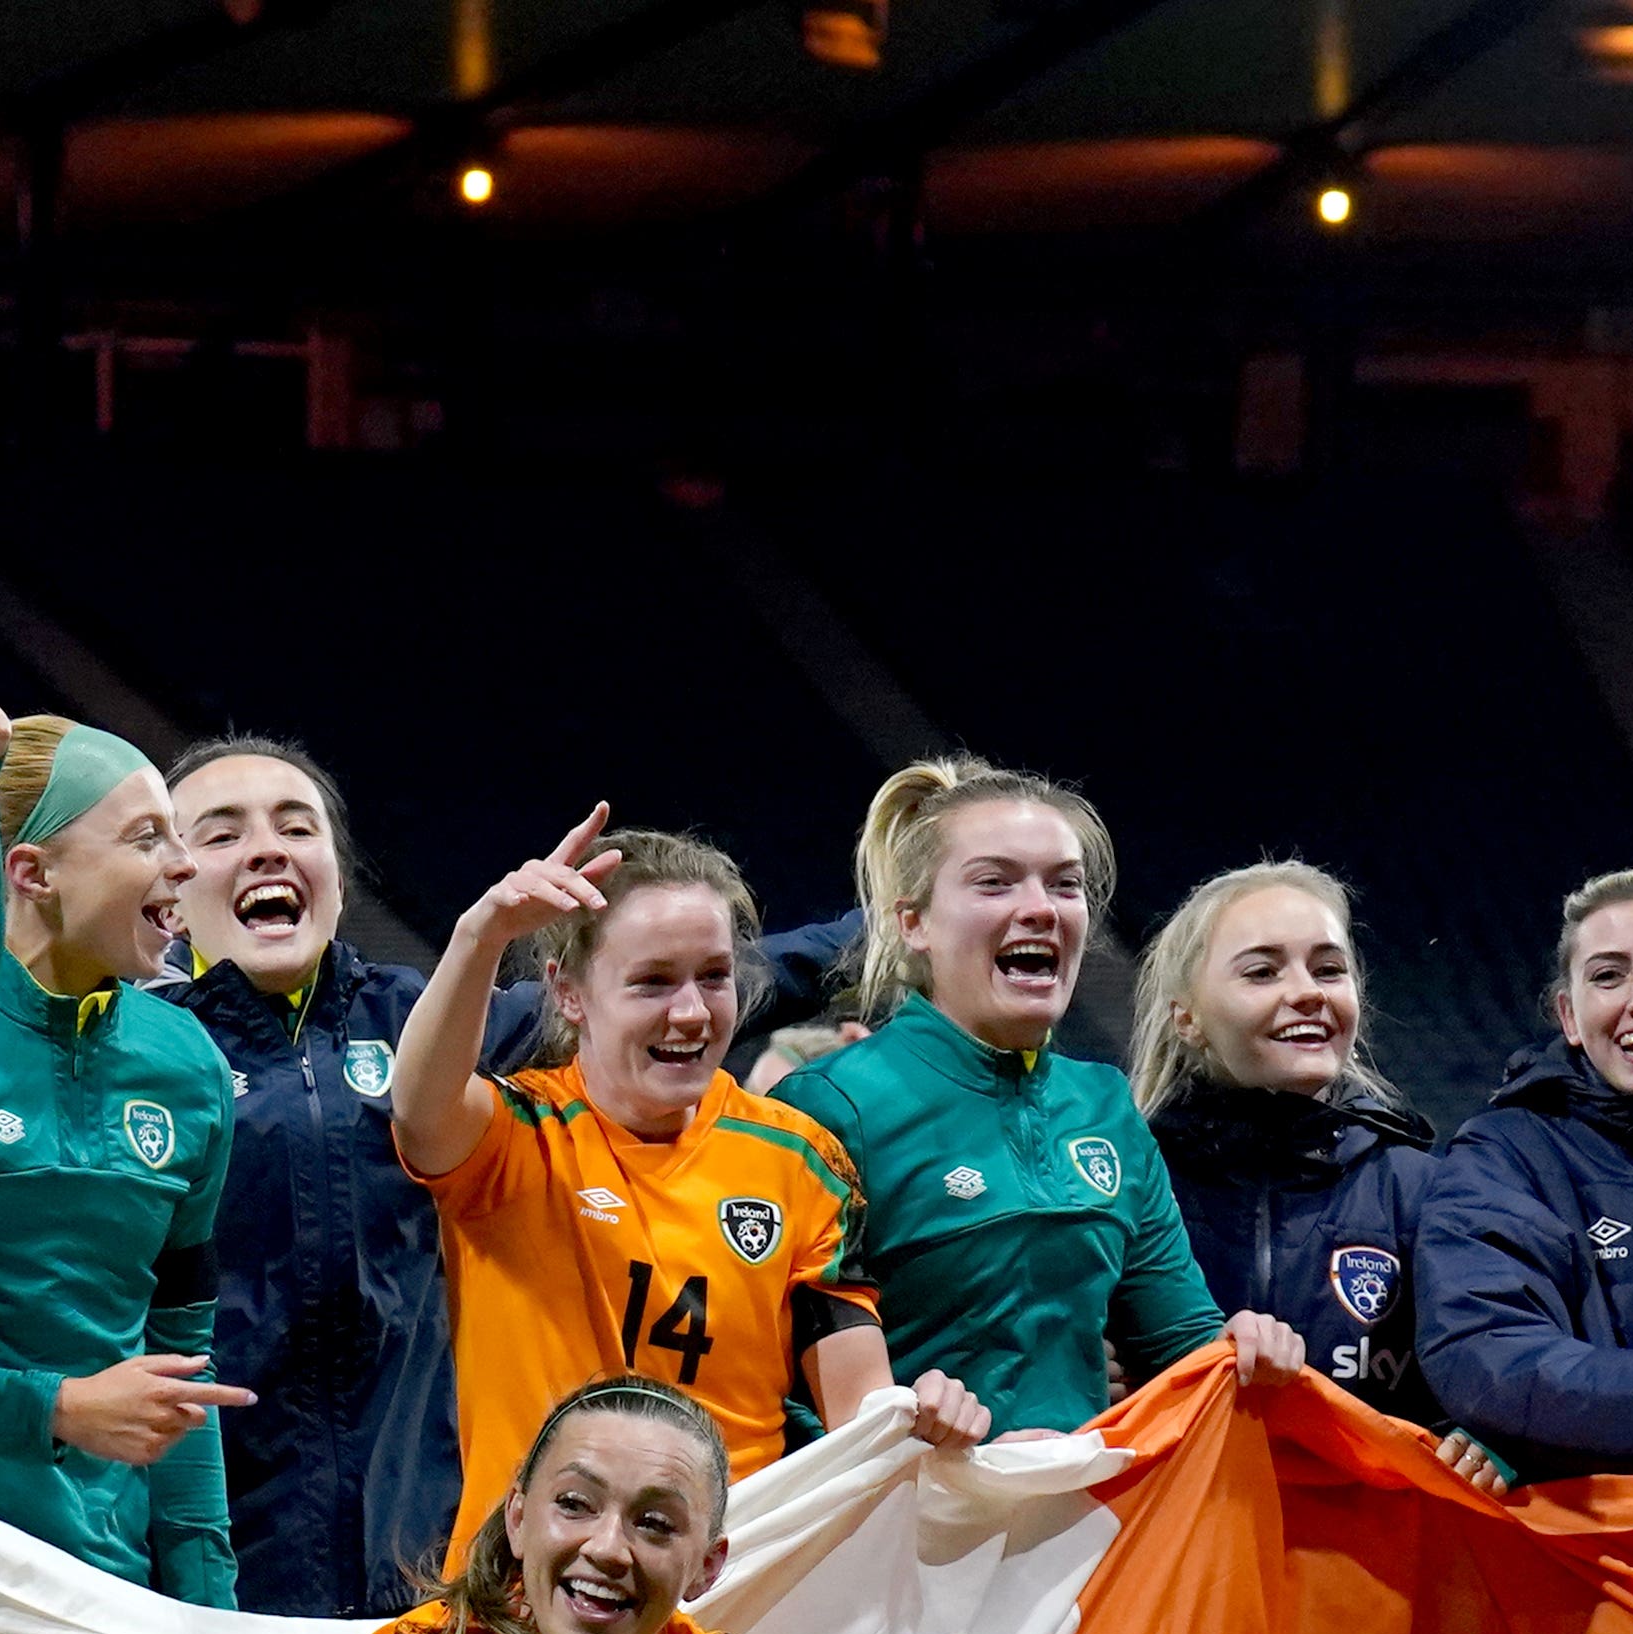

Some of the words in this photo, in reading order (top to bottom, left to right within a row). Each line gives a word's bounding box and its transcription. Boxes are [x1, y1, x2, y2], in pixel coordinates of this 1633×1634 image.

[132, 1108, 164, 1124] Ireland
[731, 1204, 770, 1219] Ireland
[1345, 1254, 1392, 1273] Ireland
[621, 1259, 715, 1386] 14
[1332, 1336, 1412, 1391] sky
